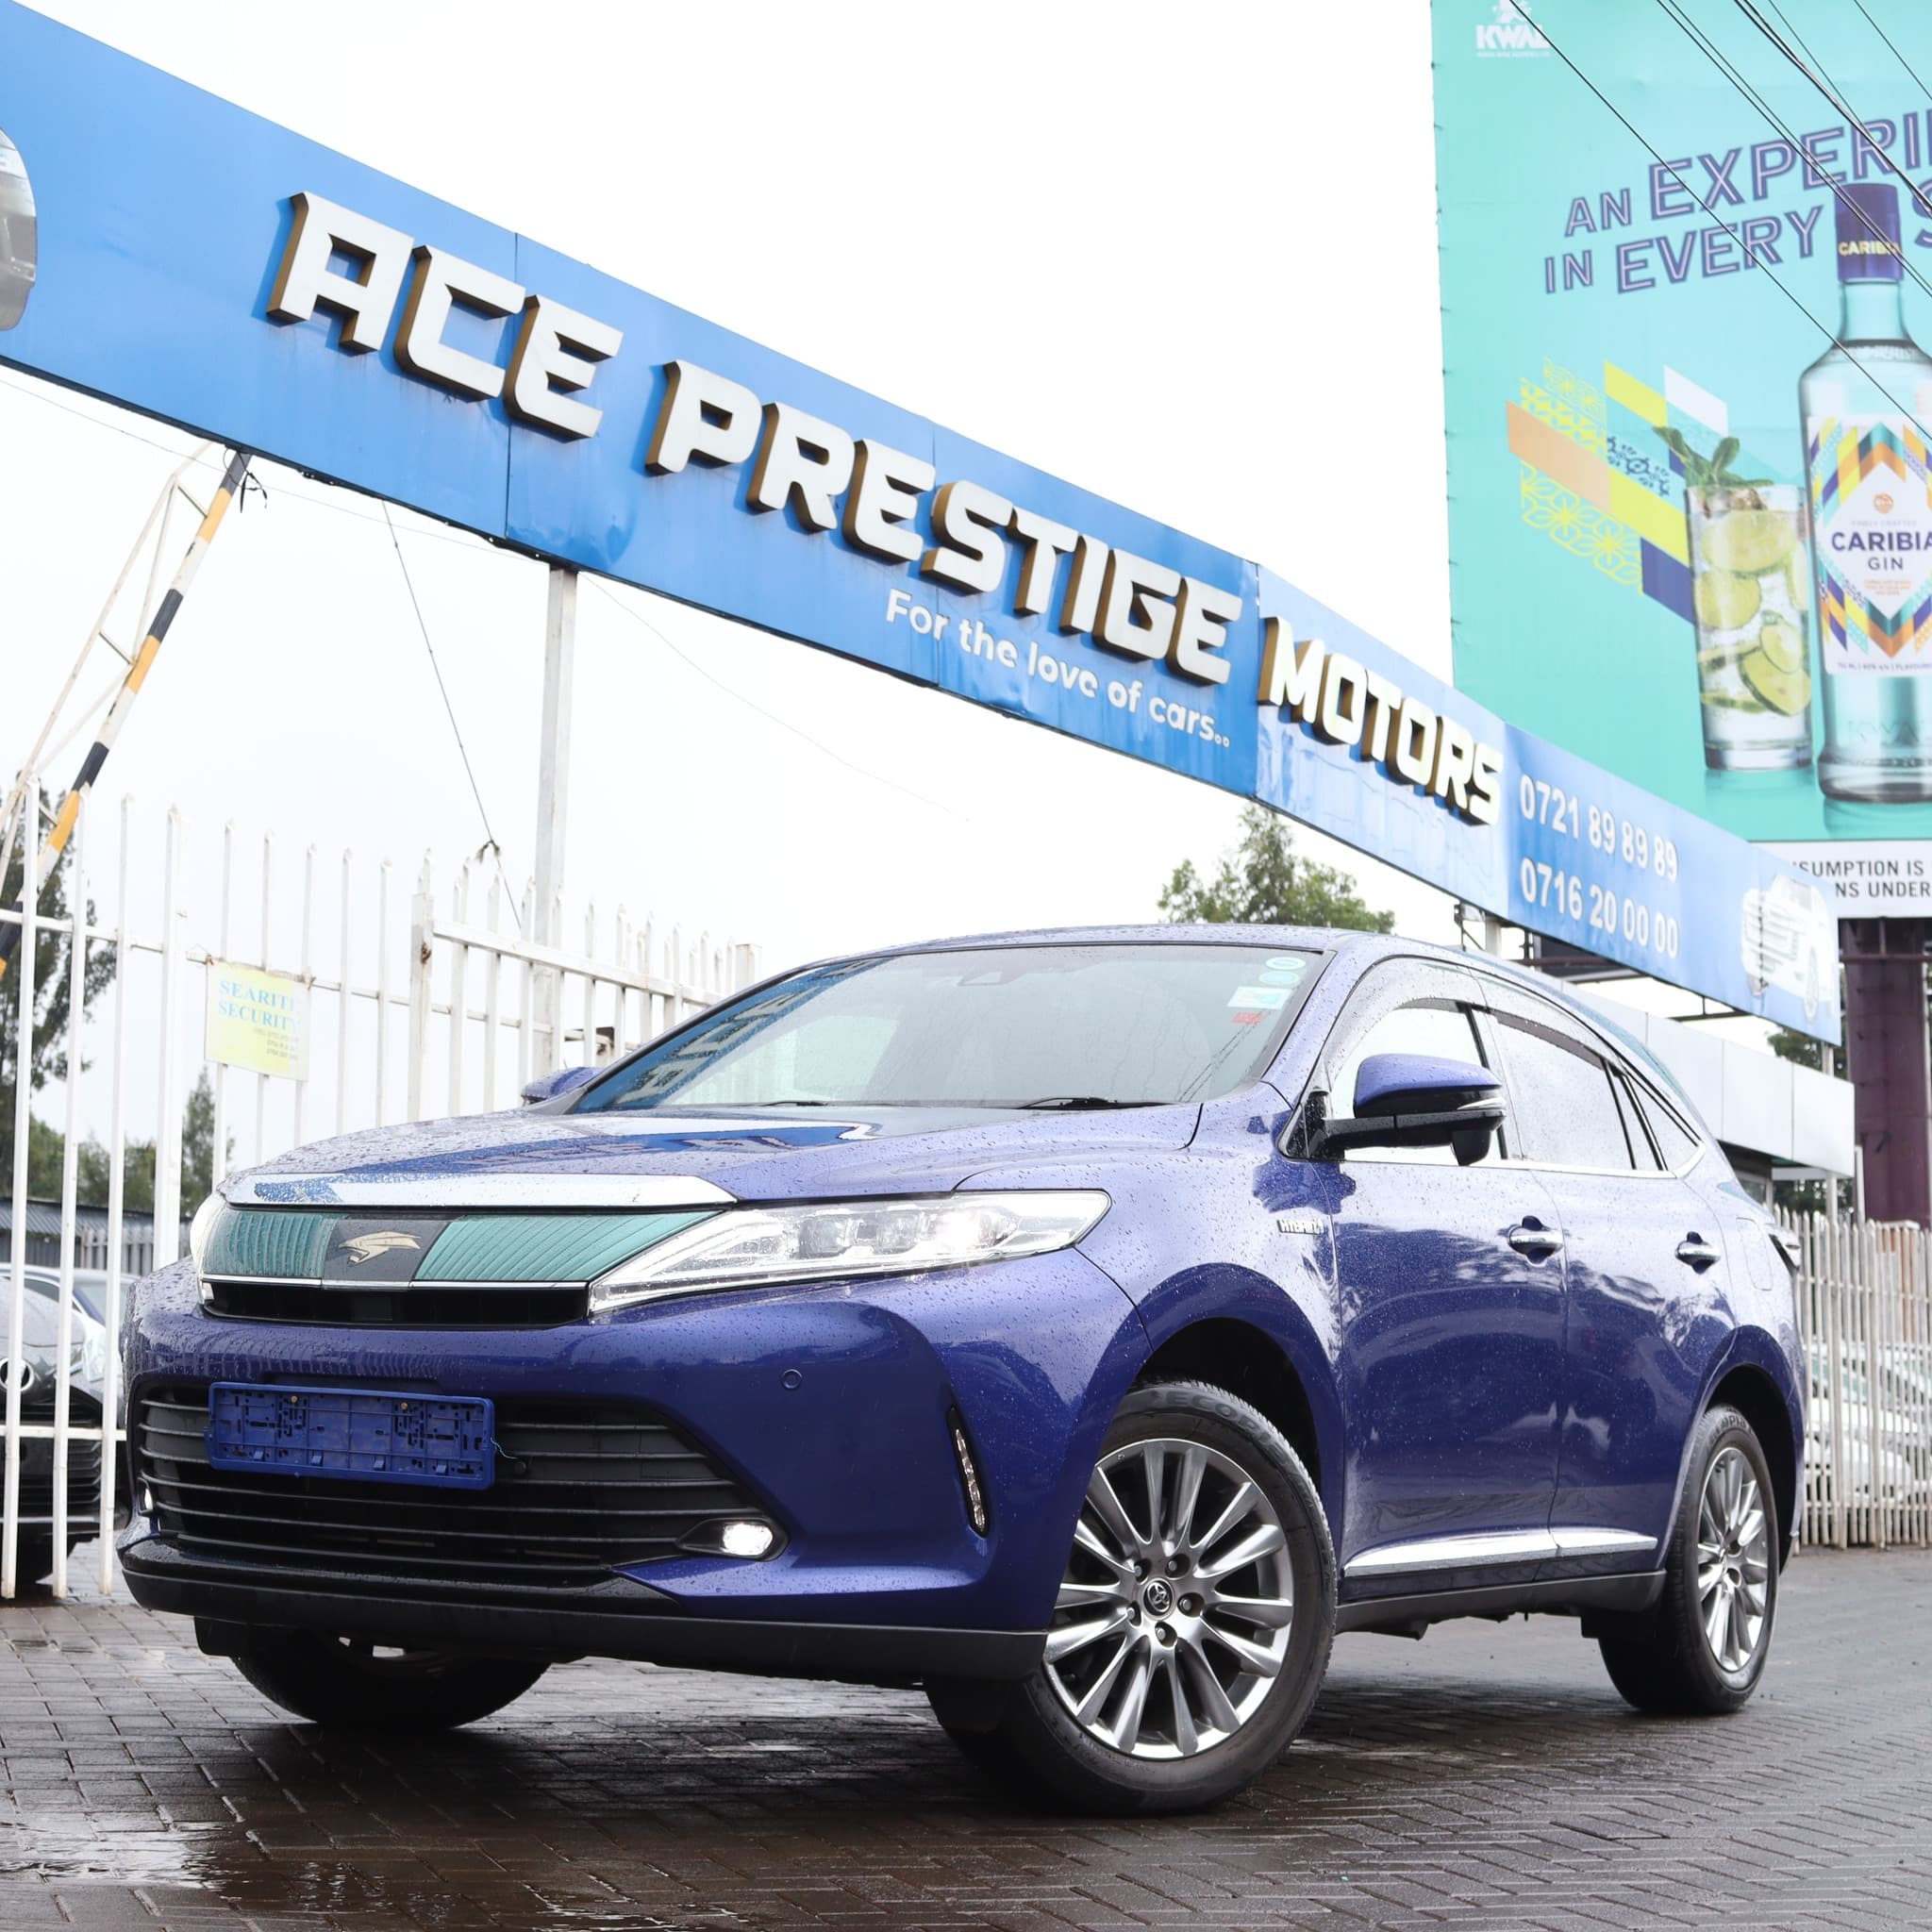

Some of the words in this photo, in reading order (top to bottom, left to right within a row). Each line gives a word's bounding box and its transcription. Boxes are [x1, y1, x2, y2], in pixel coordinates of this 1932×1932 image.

[1564, 188, 1632, 237] AN
[1648, 108, 1932, 220] EXPERI
[1545, 250, 1592, 293] IN
[1616, 205, 1824, 293] EVERY
[268, 191, 624, 442] ACE
[644, 359, 1242, 686] PRESTIGE
[1257, 616, 1504, 826] MOTORS
[1868, 557, 1904, 571] GIN
[886, 589, 949, 641] For
[958, 618, 1018, 669] the
[1027, 641, 1099, 698] love
[1108, 678, 1142, 713] of
[1520, 774, 1579, 839] 0721
[1589, 805, 1616, 854] 89
[1622, 821, 1649, 868] 89
[1654, 835, 1678, 883] 89
[1793, 860, 1898, 876] SUMPTION
[1907, 860, 1924, 875] IS
[1521, 858, 1582, 921] 0716
[1590, 884, 1617, 934] 20
[1624, 898, 1649, 947] 00
[1656, 912, 1679, 958] 00
[1868, 881, 1932, 897] UNDER
[218, 1001, 302, 1035] SECURITY
